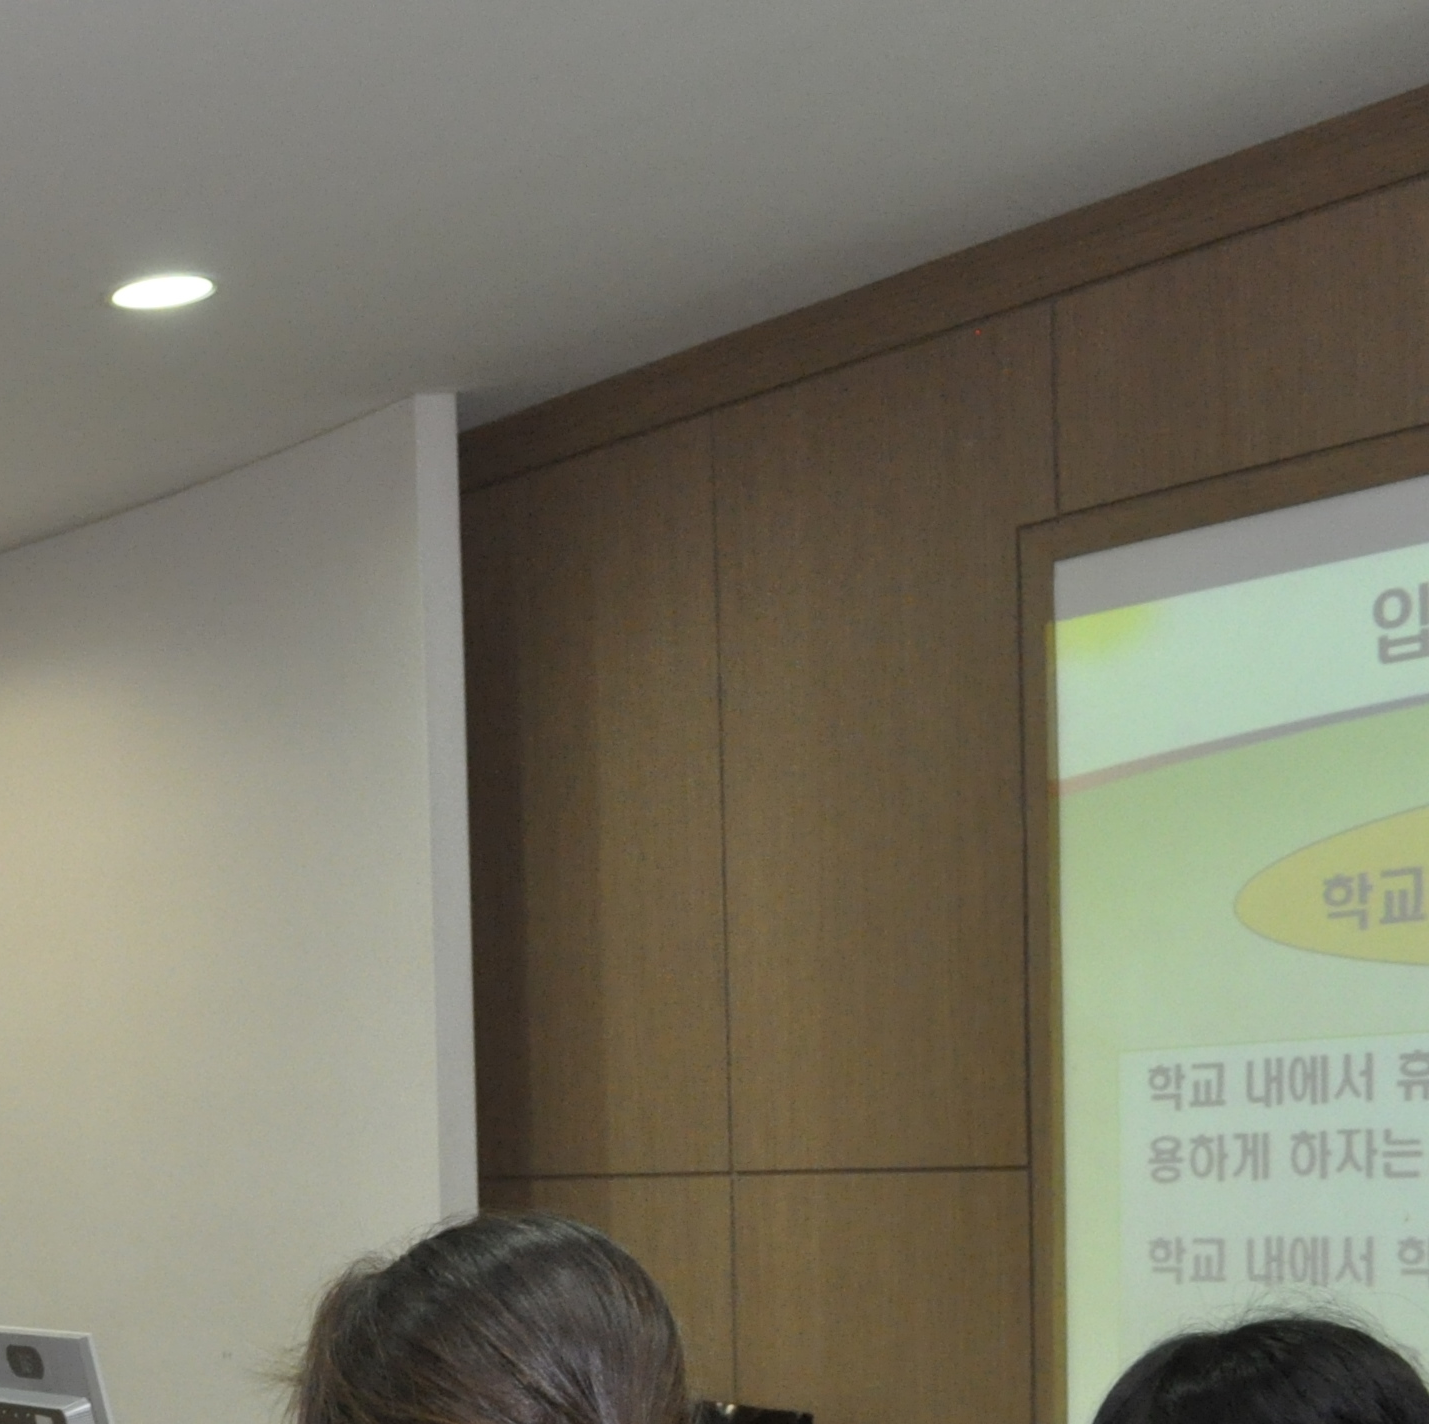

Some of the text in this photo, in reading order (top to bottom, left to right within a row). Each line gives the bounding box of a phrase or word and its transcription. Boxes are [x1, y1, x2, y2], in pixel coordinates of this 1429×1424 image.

[1323, 866, 1427, 930] 학교
[1148, 1050, 1429, 1111] 학교 내에서 휴
[1148, 1128, 1423, 1184] 용하게 하자는
[1148, 1236, 1226, 1285] 학교
[1246, 1236, 1374, 1287] 내에서
